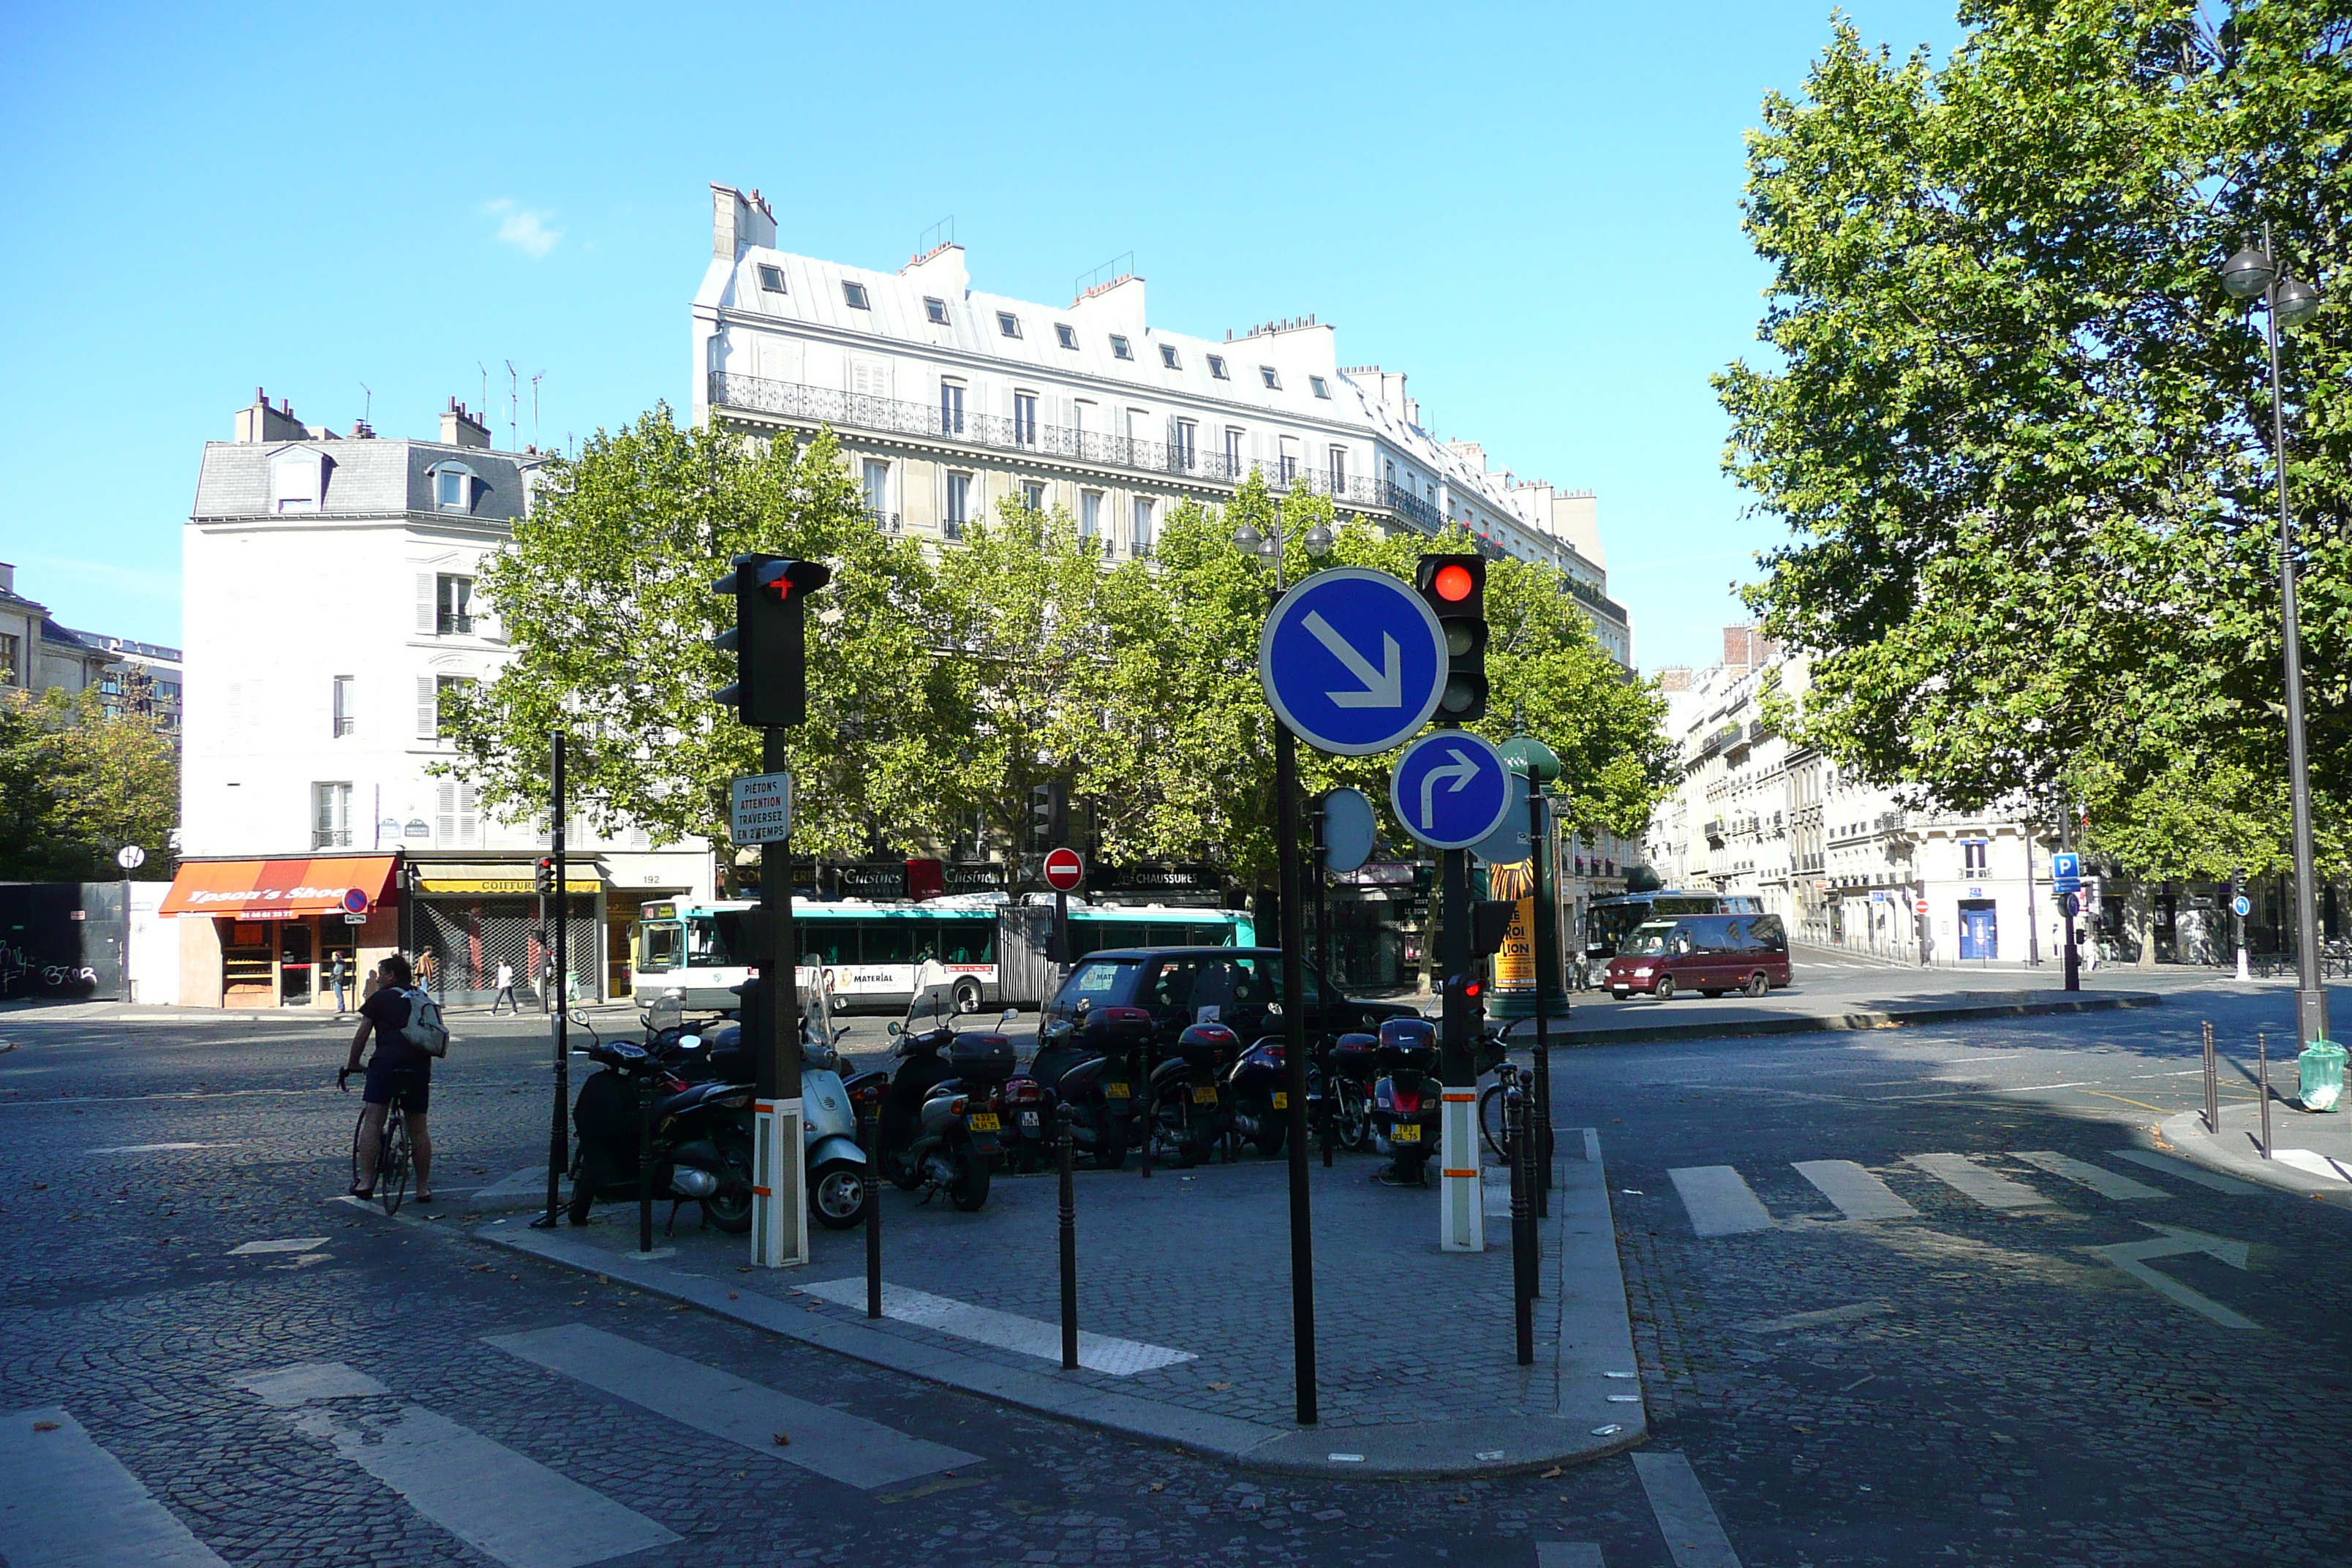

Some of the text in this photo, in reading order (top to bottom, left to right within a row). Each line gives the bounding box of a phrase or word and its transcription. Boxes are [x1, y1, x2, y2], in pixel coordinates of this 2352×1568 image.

[740, 796, 781, 810] ATTENTION
[739, 811, 783, 826] TRAVERSEZ
[737, 829, 747, 840] EN
[2059, 859, 2071, 875] P
[644, 875, 660, 884] 192
[844, 869, 902, 884] Cuisines
[1136, 873, 1198, 884] CHAUSSURES
[187, 887, 347, 904] Ypson's Shoe
[1511, 910, 1520, 920] E
[1505, 924, 1525, 941] ROI
[1502, 940, 1530, 957] LION
[853, 970, 894, 983] MATERIAL
